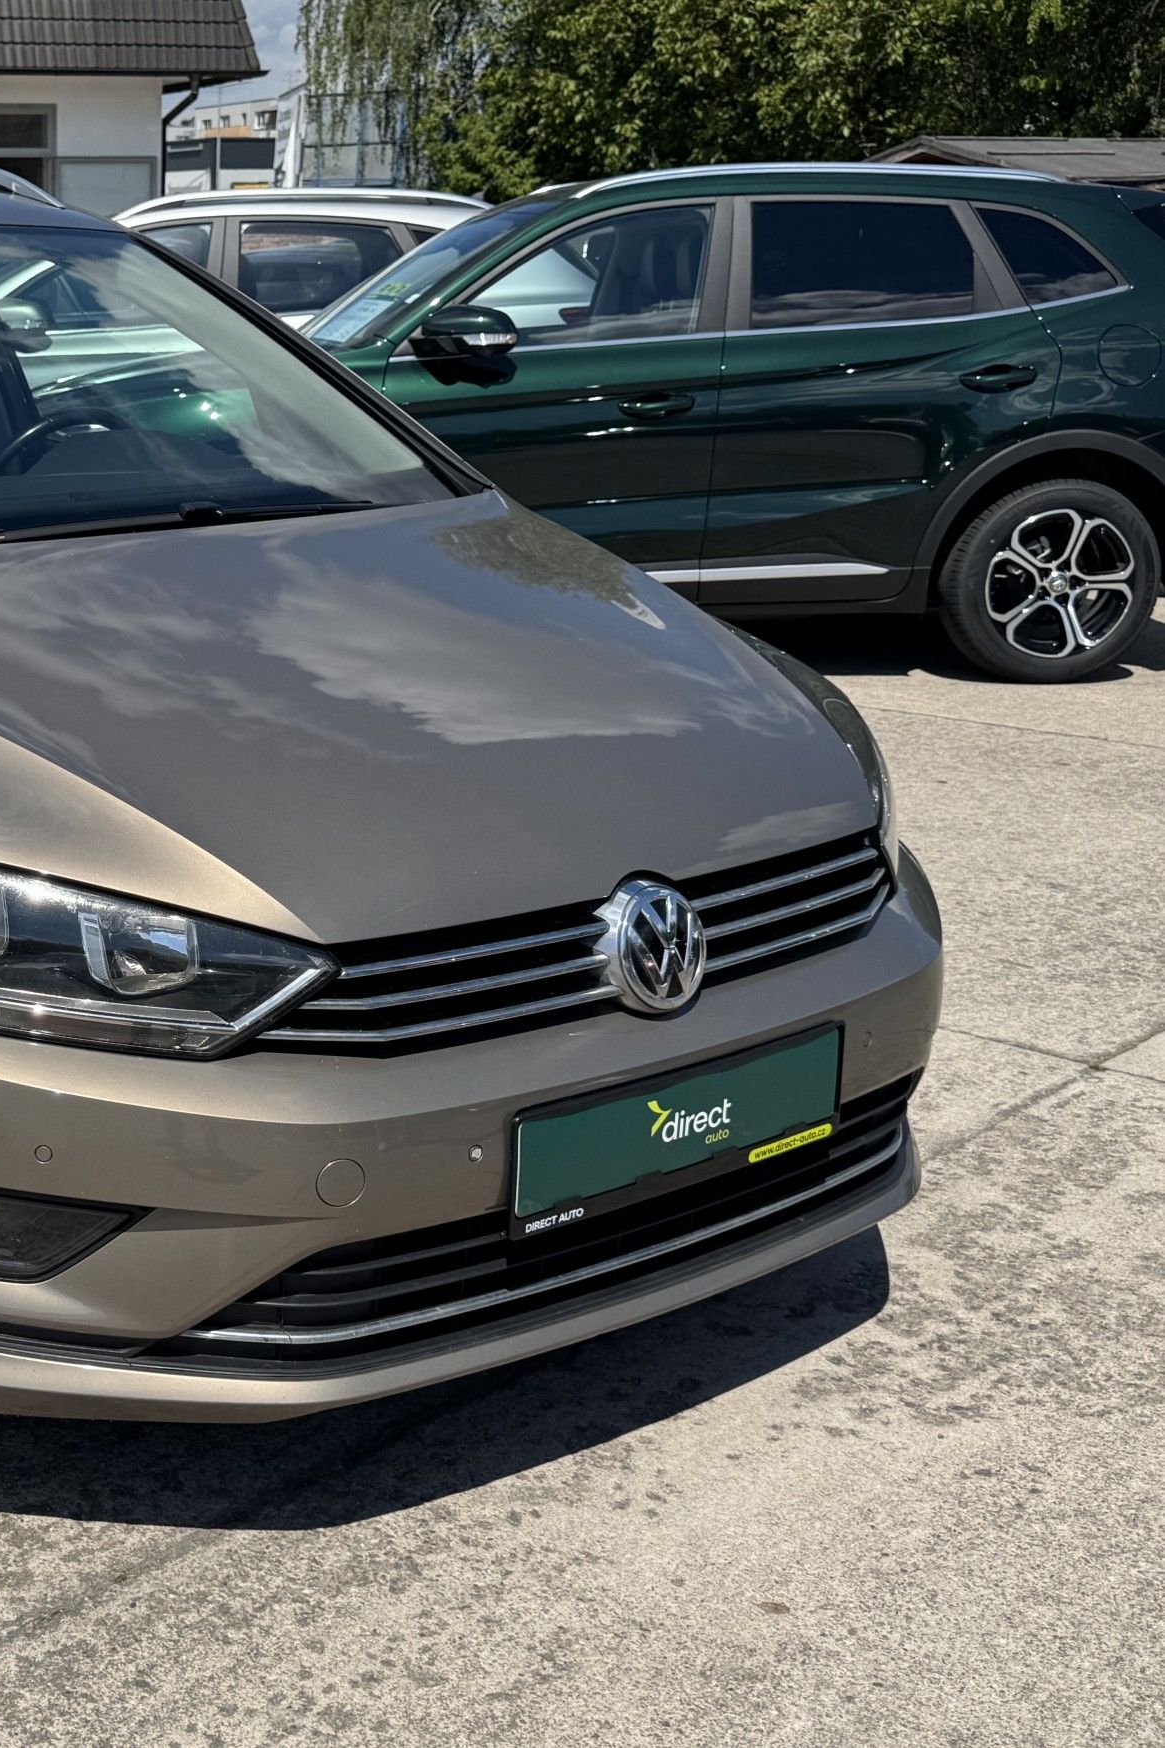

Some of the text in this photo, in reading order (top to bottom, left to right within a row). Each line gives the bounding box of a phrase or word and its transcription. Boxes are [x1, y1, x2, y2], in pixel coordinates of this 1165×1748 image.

[661, 1098, 732, 1143] direct
[705, 1129, 730, 1144] auto
[754, 1128, 826, 1160] www.direct-auto.cz
[525, 1207, 584, 1233] DIRECT AUTO
